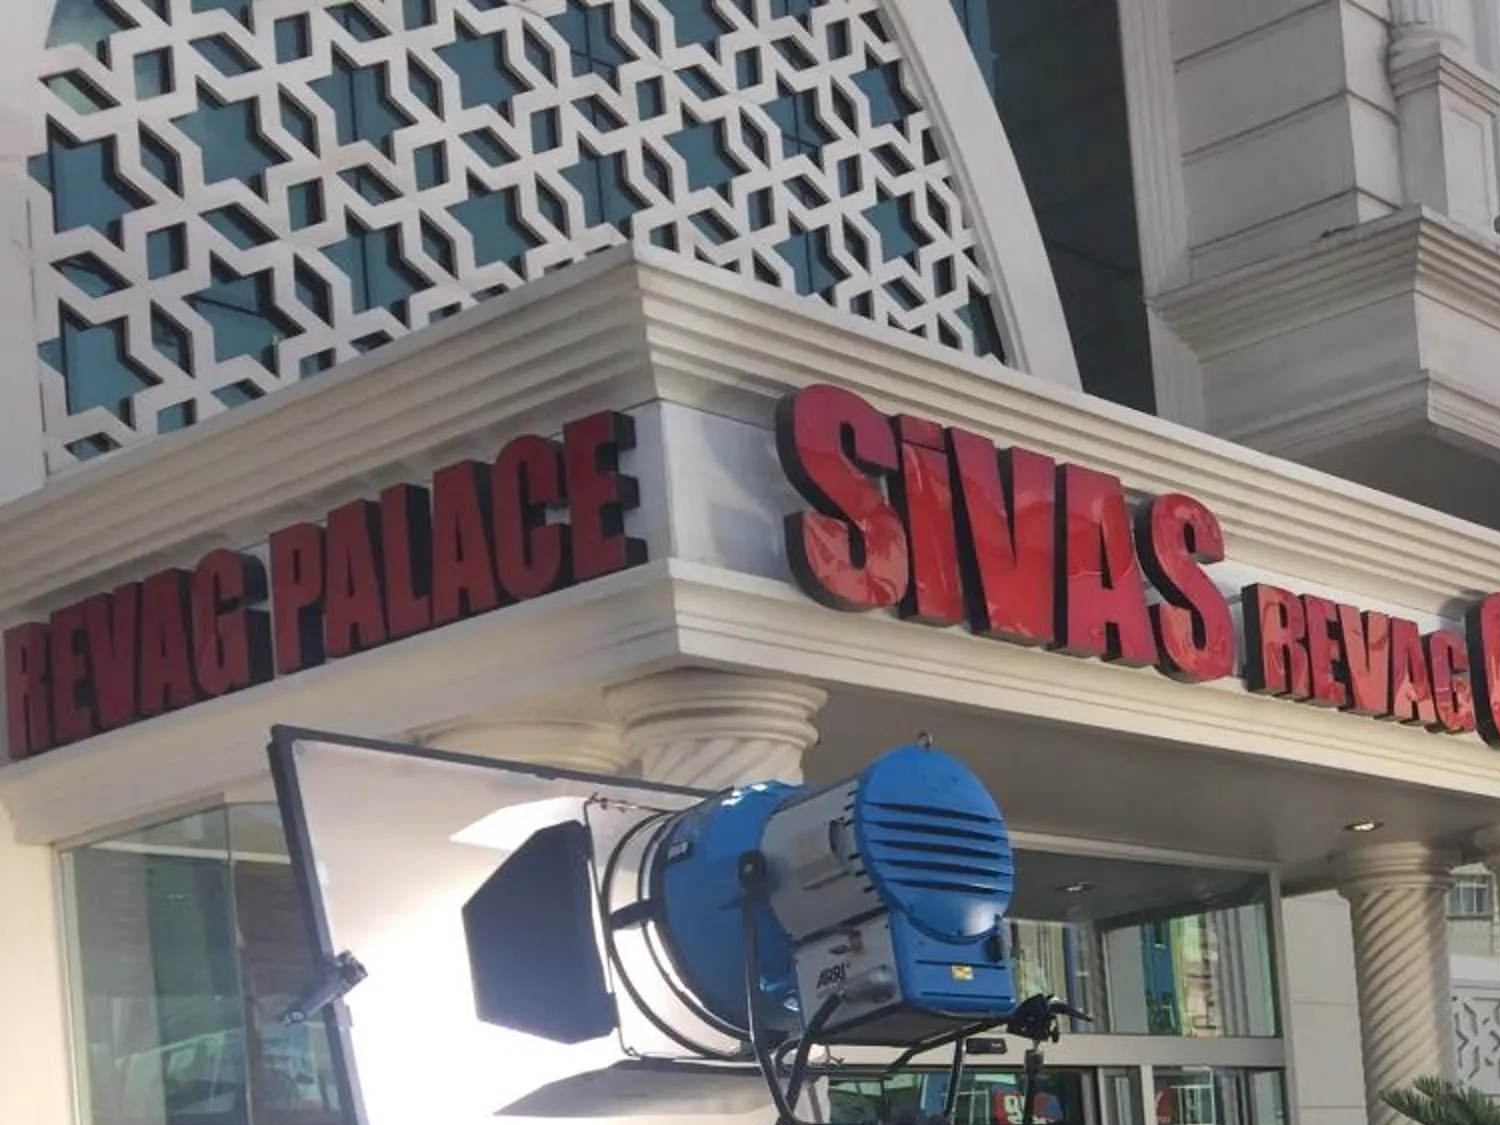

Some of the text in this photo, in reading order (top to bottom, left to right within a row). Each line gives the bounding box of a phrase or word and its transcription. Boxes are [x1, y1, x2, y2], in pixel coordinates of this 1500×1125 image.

[3, 409, 648, 760] REVAG PALACE
[1241, 583, 1474, 733] REVAG
